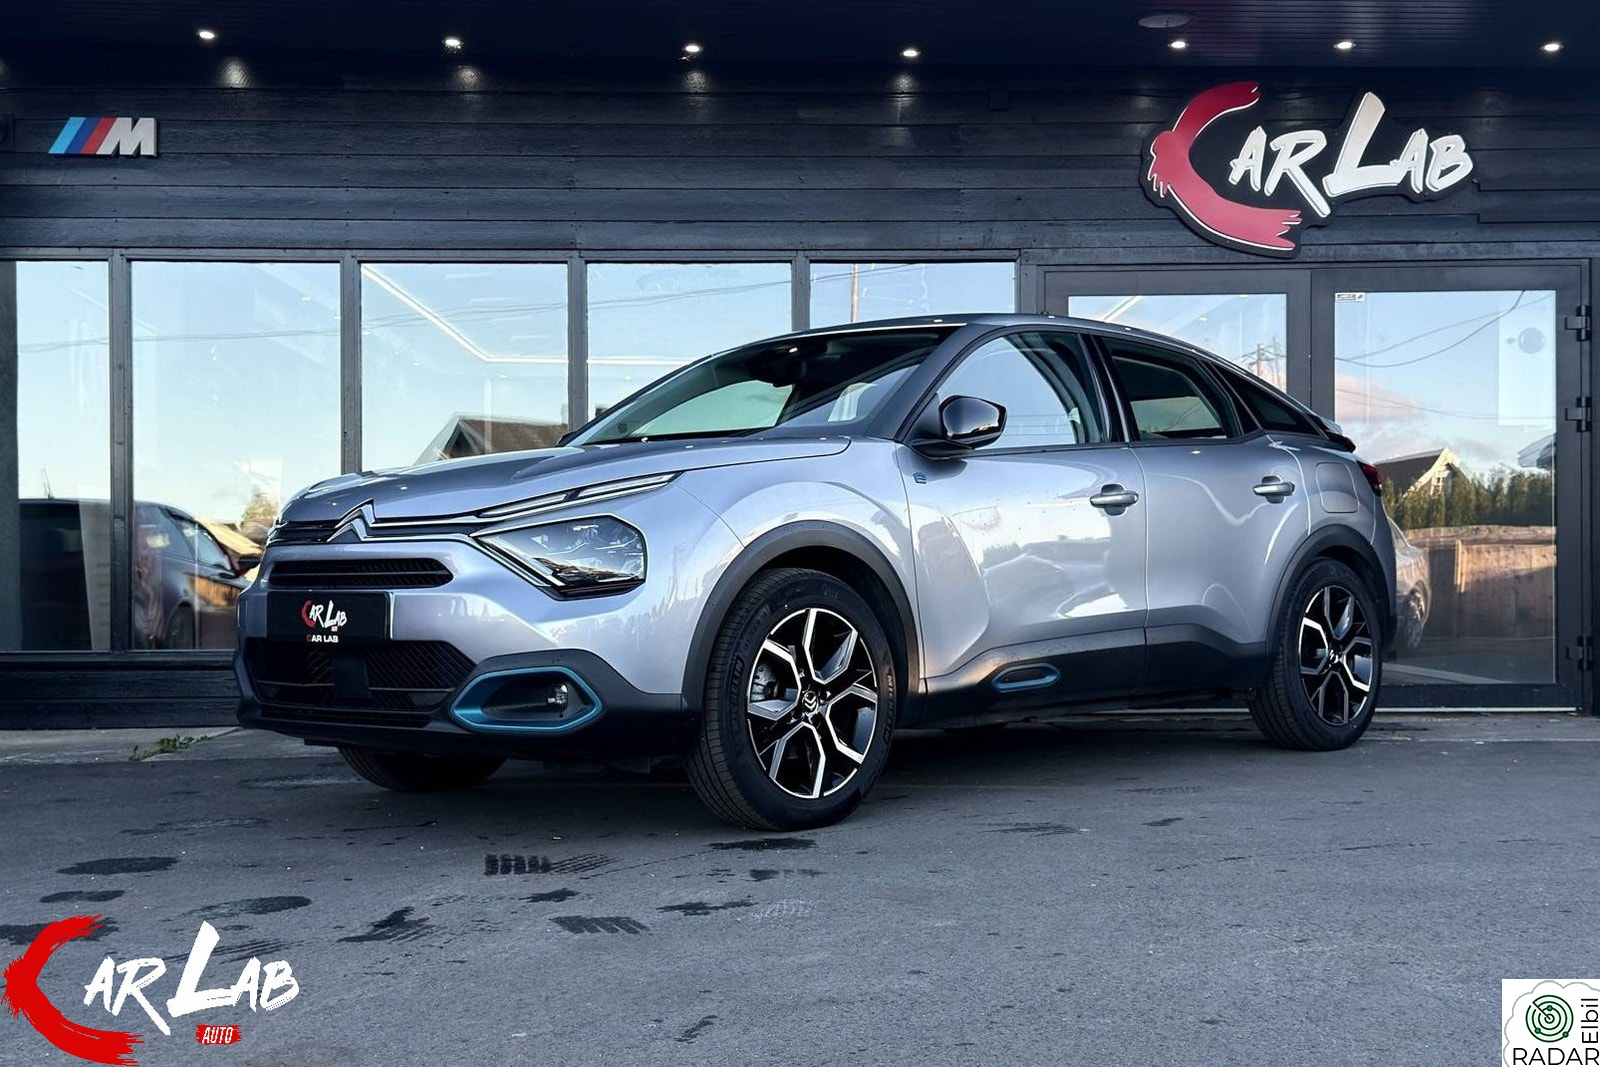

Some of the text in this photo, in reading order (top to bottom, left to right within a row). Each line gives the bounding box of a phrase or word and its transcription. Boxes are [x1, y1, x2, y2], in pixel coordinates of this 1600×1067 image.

[1147, 81, 1474, 250] CAR LAB
[301, 600, 348, 628] CAR LAB
[306, 634, 339, 643] CAR LAB
